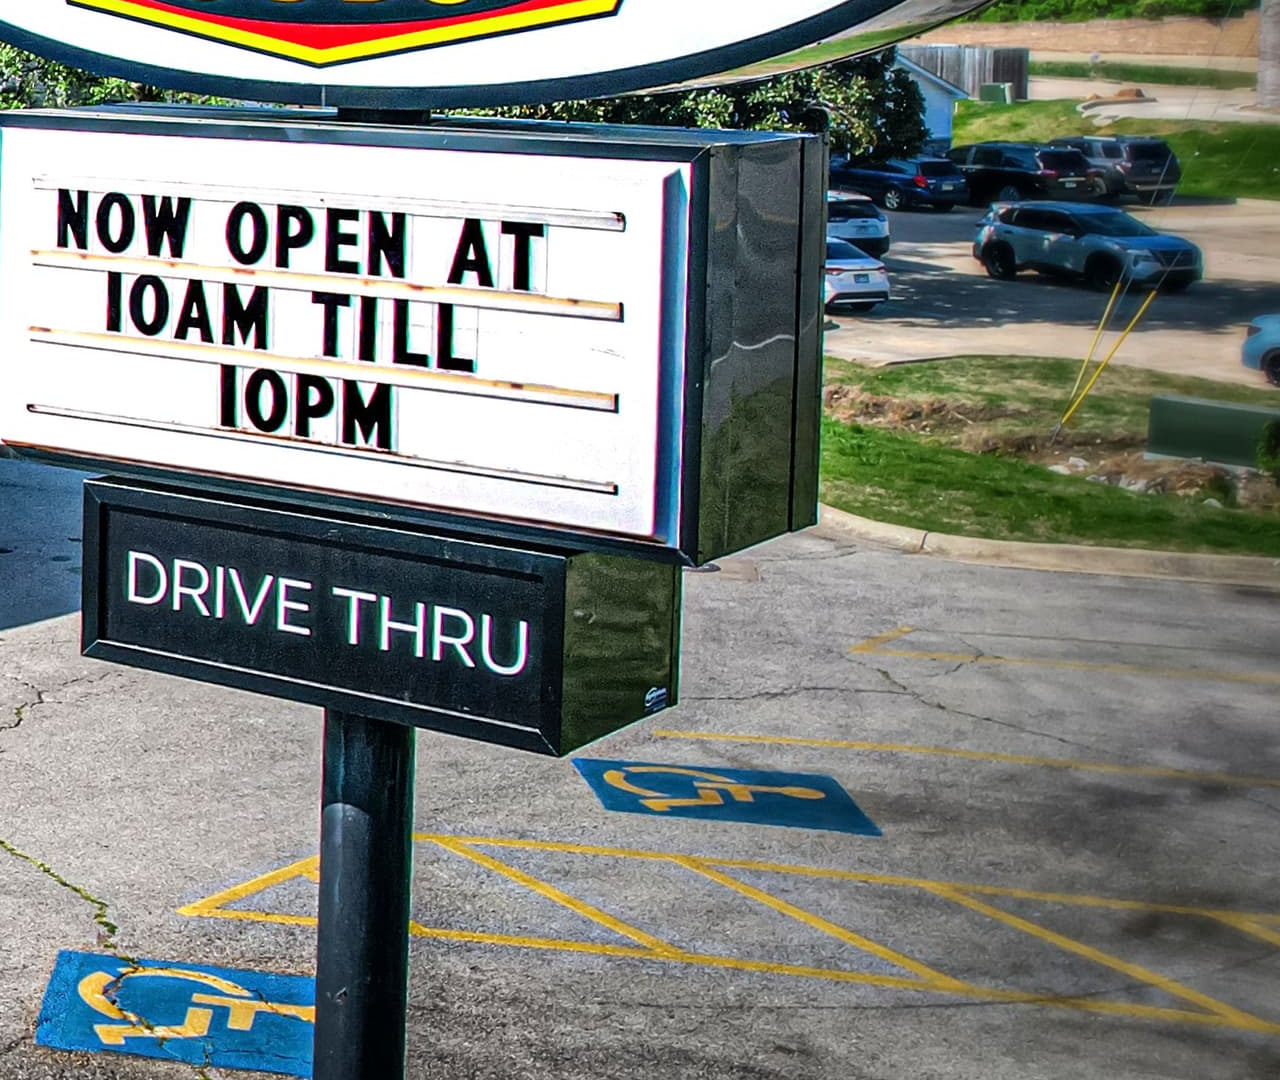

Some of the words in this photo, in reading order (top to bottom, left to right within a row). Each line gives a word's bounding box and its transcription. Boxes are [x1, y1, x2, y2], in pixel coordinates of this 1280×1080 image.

[56, 188, 193, 259] NOW
[225, 201, 408, 279] OPEN
[446, 218, 546, 292] AT
[106, 271, 270, 351] 10AM
[311, 291, 478, 374] TILL
[220, 364, 394, 452] 10PM
[126, 549, 313, 637] DRIVE
[332, 586, 530, 677] THRU
